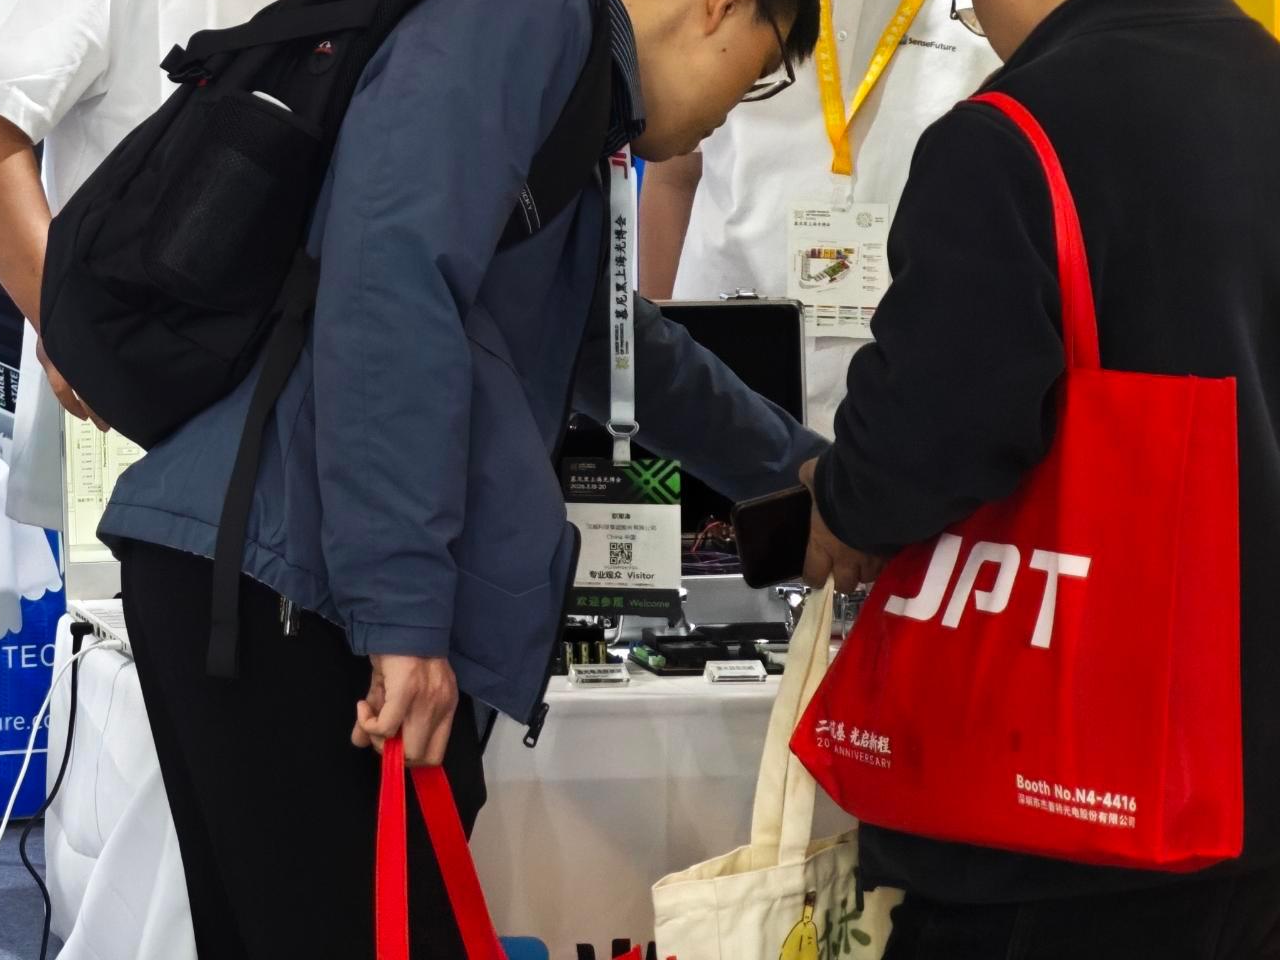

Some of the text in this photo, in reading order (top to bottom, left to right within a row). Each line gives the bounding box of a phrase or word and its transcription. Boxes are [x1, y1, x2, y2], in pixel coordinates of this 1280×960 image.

[908, 37, 957, 52] SenseFuture
[614, 214, 629, 321] 慕尼黑上海光博会
[627, 572, 655, 580] Visitor
[883, 532, 1092, 649] JPT
[630, 599, 671, 609] Welcome
[834, 744, 892, 769] ANNIVERSARY
[1016, 773, 1137, 812] Booth No.N4-4416
